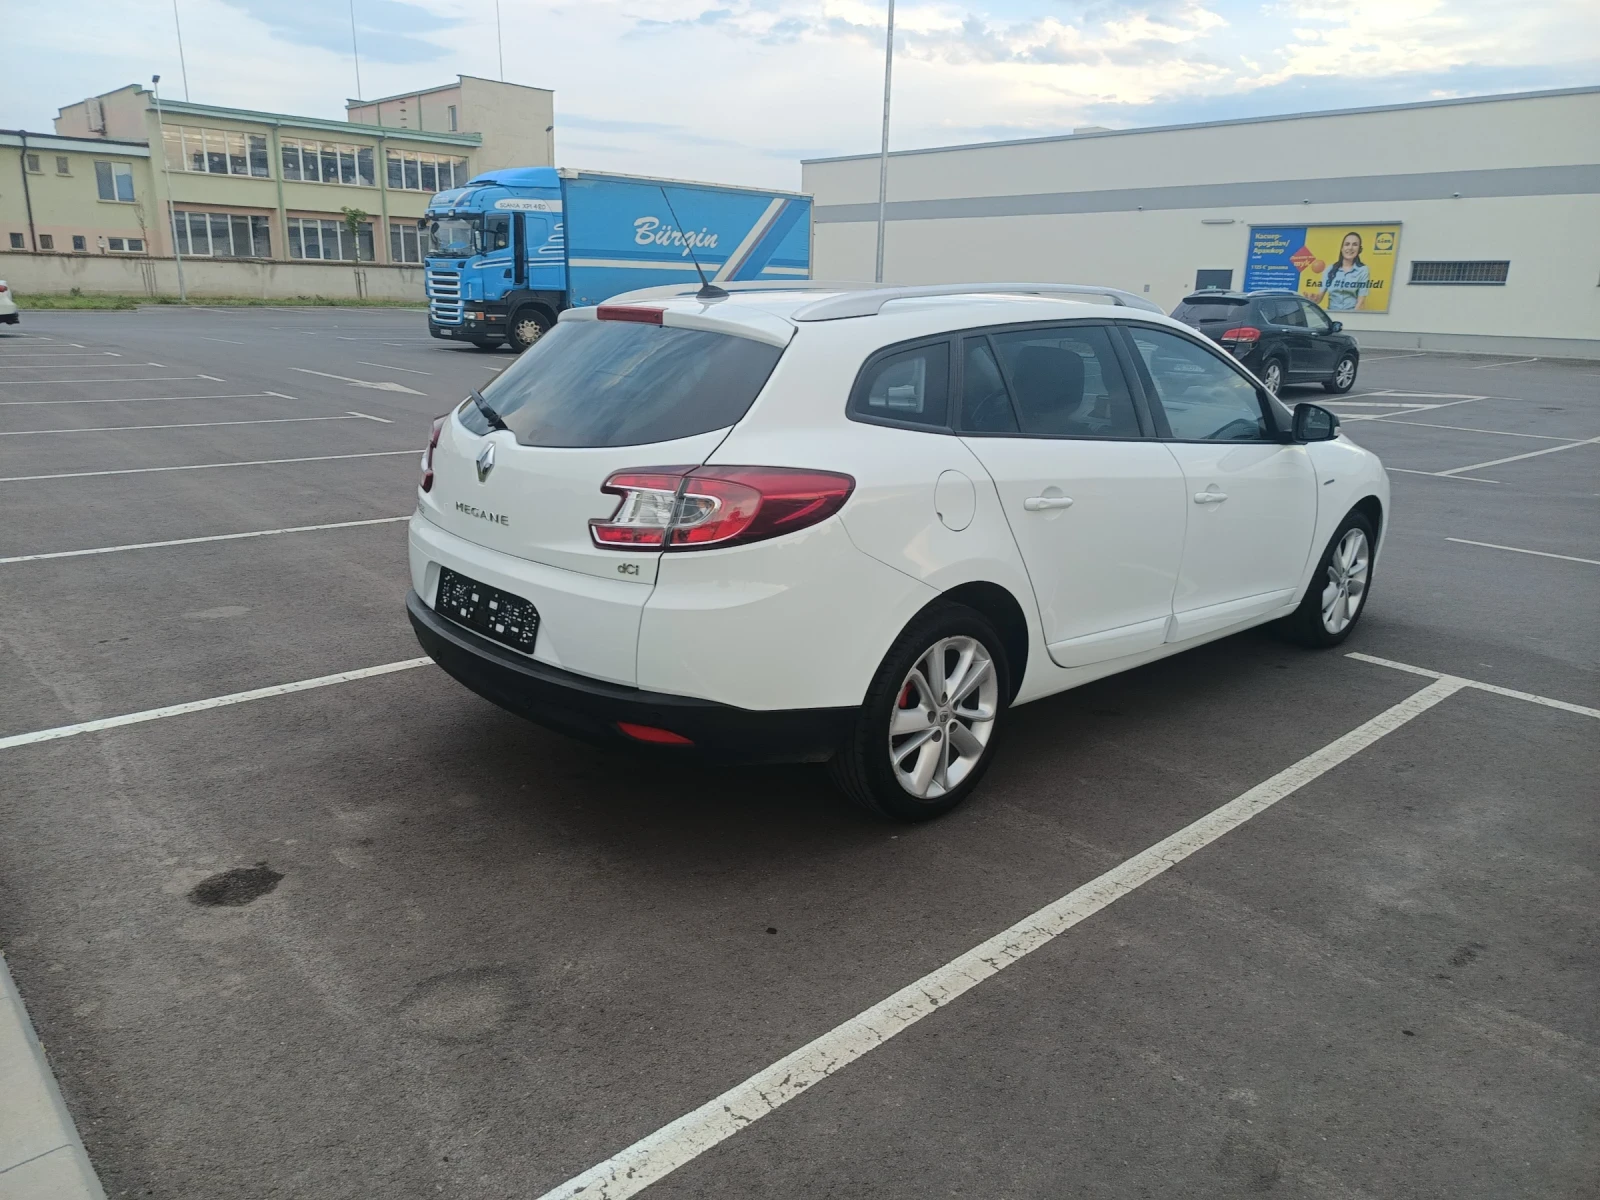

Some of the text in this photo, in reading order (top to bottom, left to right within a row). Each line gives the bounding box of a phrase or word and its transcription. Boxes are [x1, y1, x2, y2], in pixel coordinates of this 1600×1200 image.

[633, 216, 718, 257] Bürgin
[1306, 279, 1323, 288] Ела
[1334, 280, 1384, 289] #teamlidl
[455, 501, 510, 527] MEGANE
[617, 562, 640, 576] dCi
